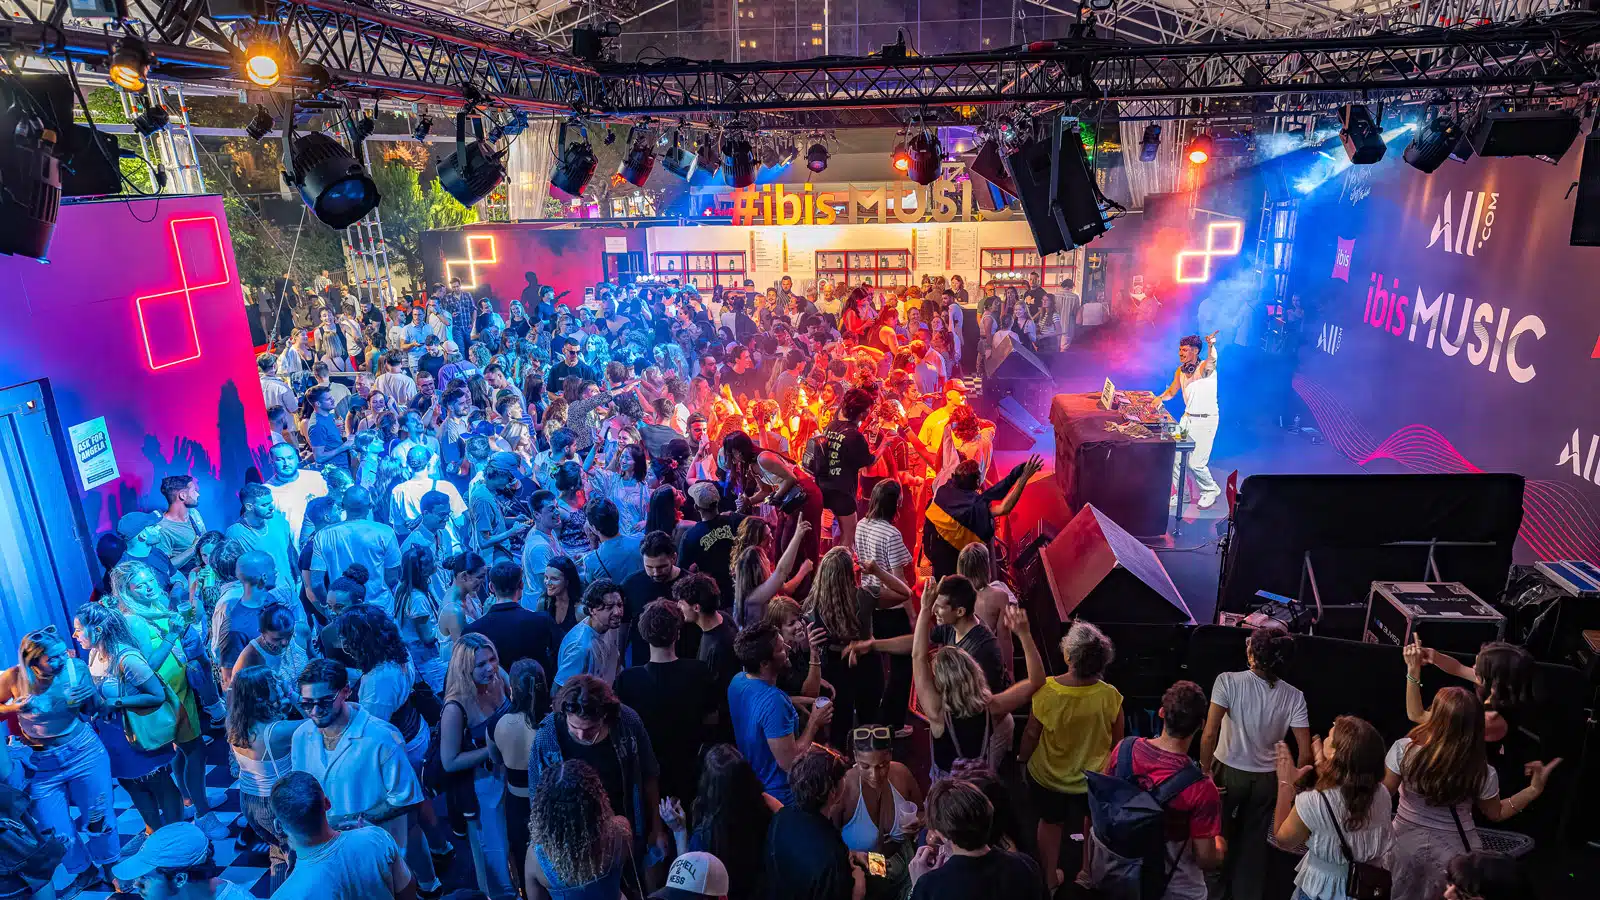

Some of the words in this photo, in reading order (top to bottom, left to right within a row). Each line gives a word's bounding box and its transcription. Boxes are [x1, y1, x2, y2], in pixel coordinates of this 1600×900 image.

[730, 182, 836, 226] #ibis
[1336, 248, 1350, 267] ibis
[1363, 272, 1409, 337] ibis
[1408, 285, 1547, 384] MUSIC
[78, 438, 91, 452] ASK
[91, 432, 103, 446] FOR
[81, 441, 106, 461] ANGELA
[670, 859, 697, 881] CHELL
